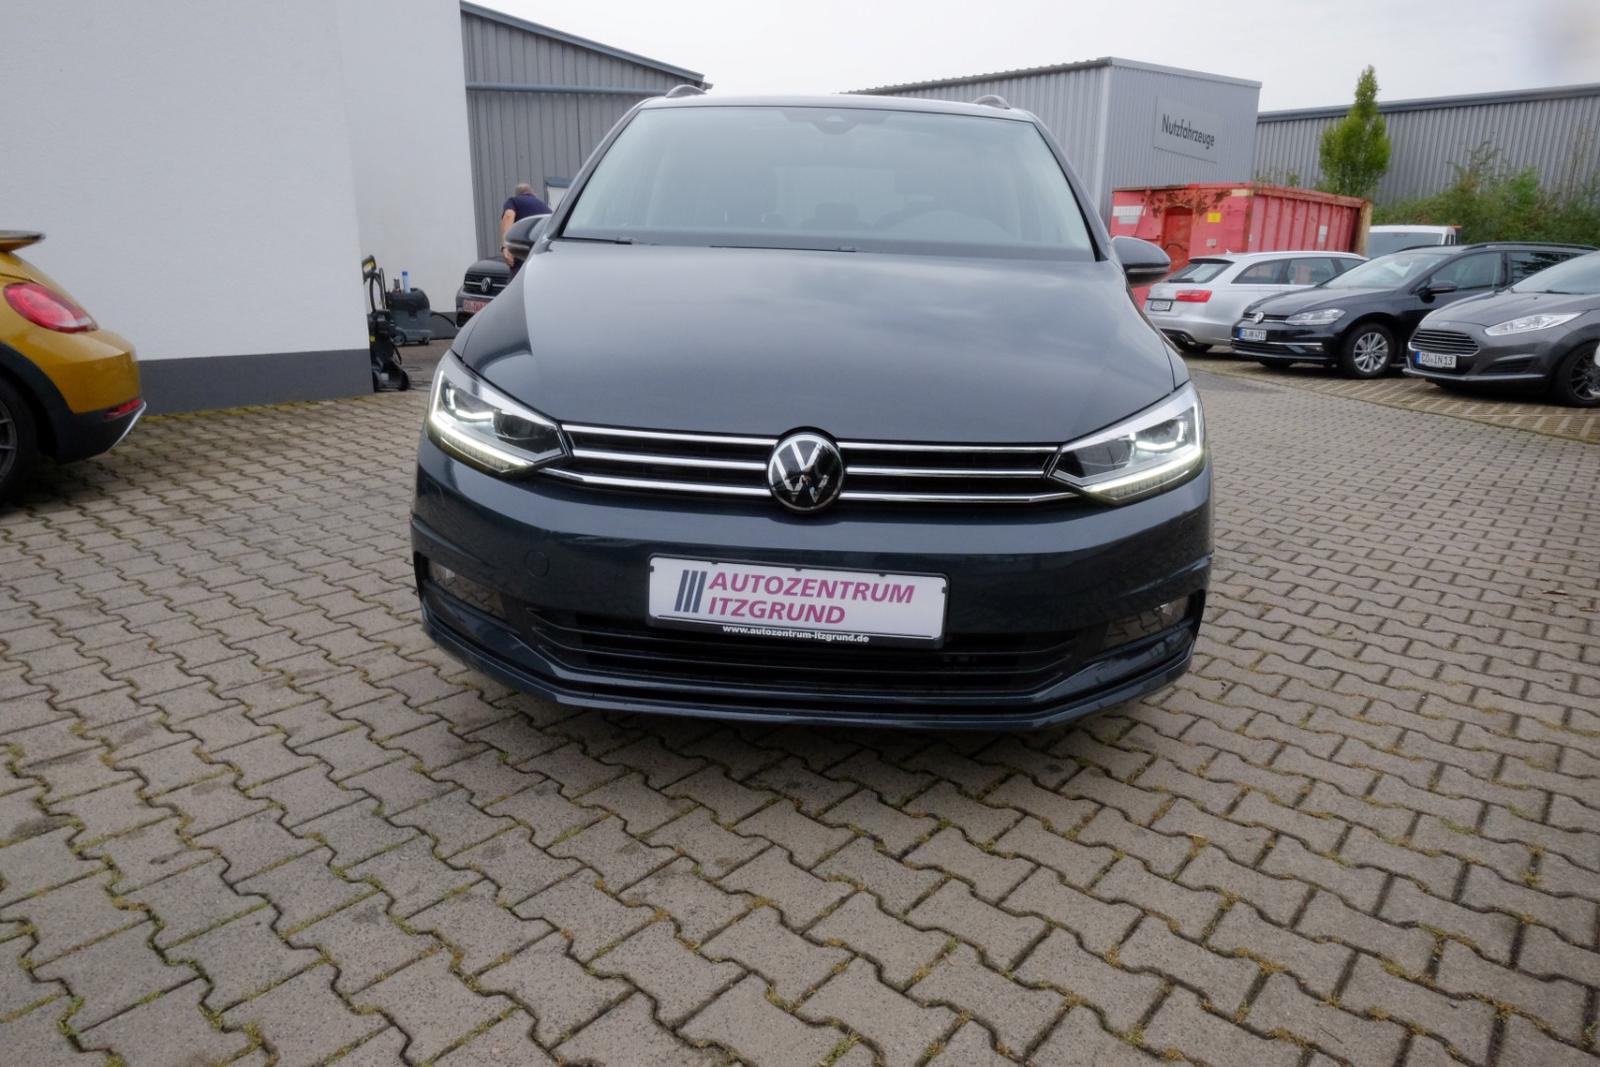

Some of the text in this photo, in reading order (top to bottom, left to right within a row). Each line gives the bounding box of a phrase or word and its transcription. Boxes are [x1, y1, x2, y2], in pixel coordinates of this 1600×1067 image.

[1161, 113, 1215, 150] Nutzfahrzeuge
[708, 571, 915, 604] AUTOZENTRUM
[708, 596, 846, 624] ITZGRUND
[722, 625, 870, 643] www.autozentrum-itzgrund.de
